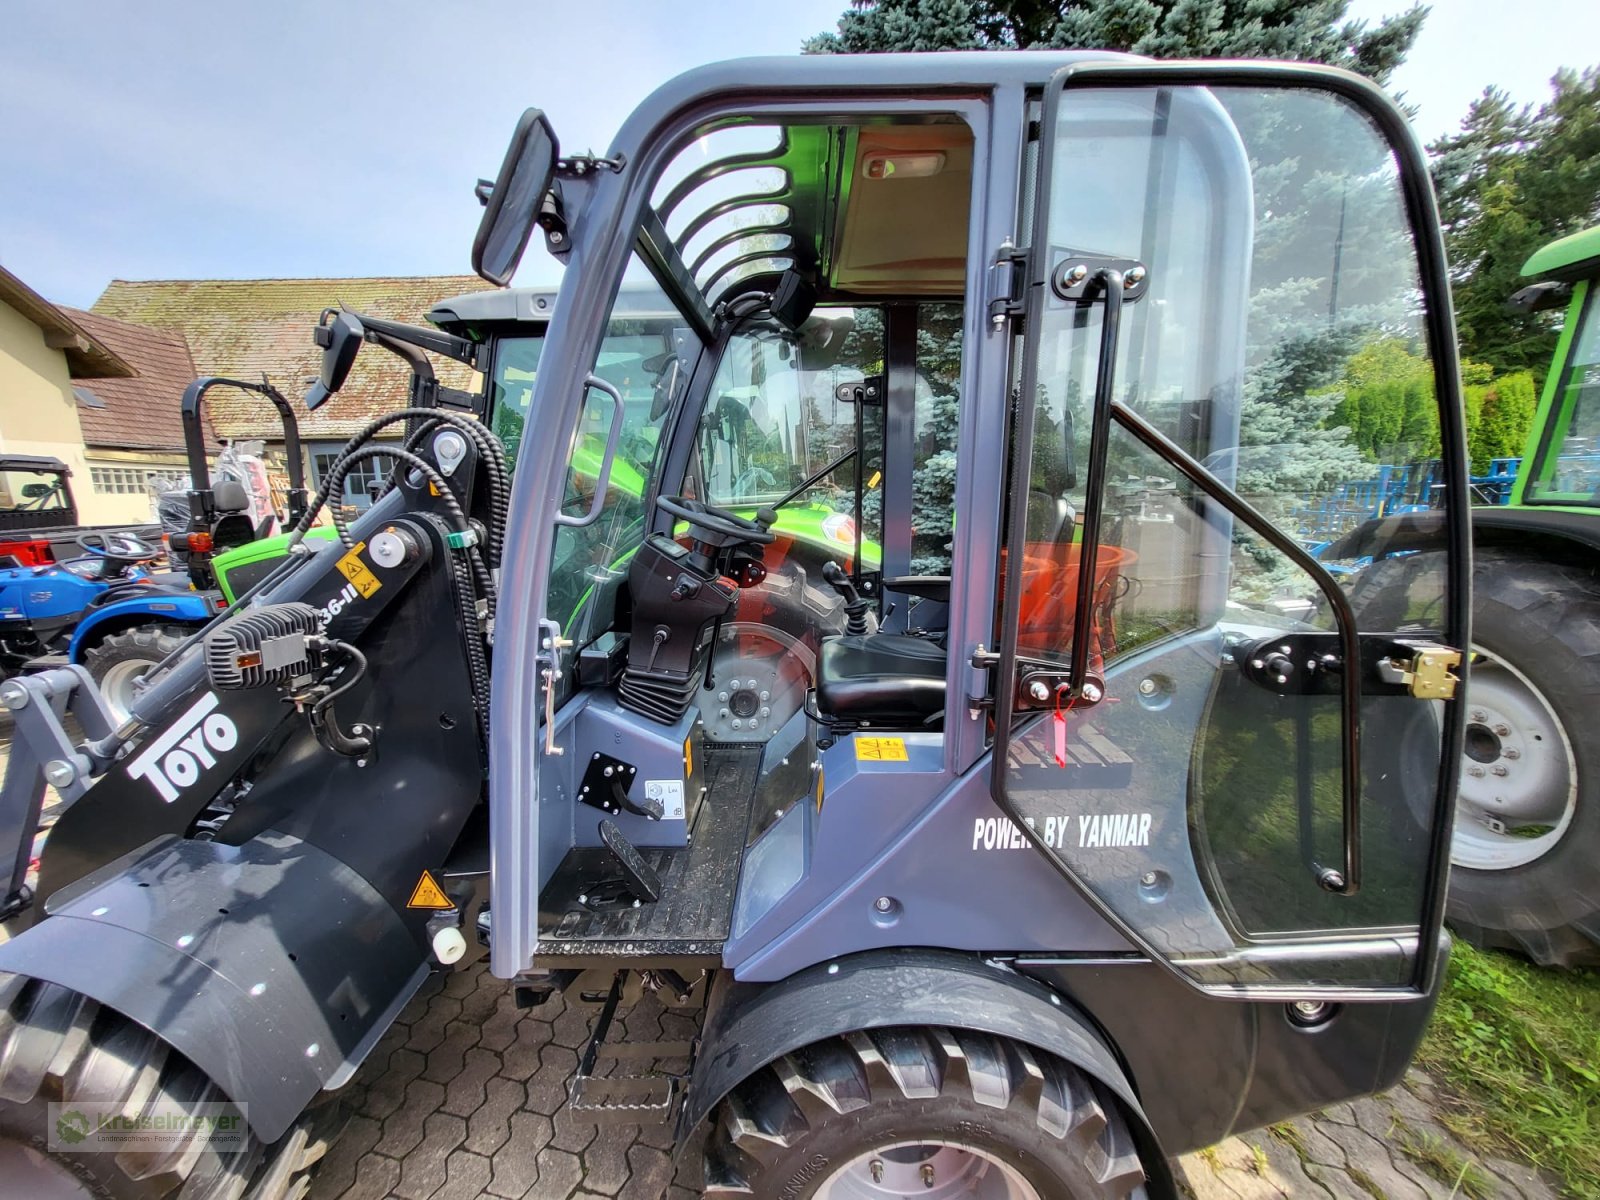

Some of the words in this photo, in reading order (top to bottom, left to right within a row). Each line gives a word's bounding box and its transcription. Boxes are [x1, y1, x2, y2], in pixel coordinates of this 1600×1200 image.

[126, 690, 238, 803] TOYO
[1044, 816, 1069, 849] BY
[1079, 813, 1152, 848] YANMAR
